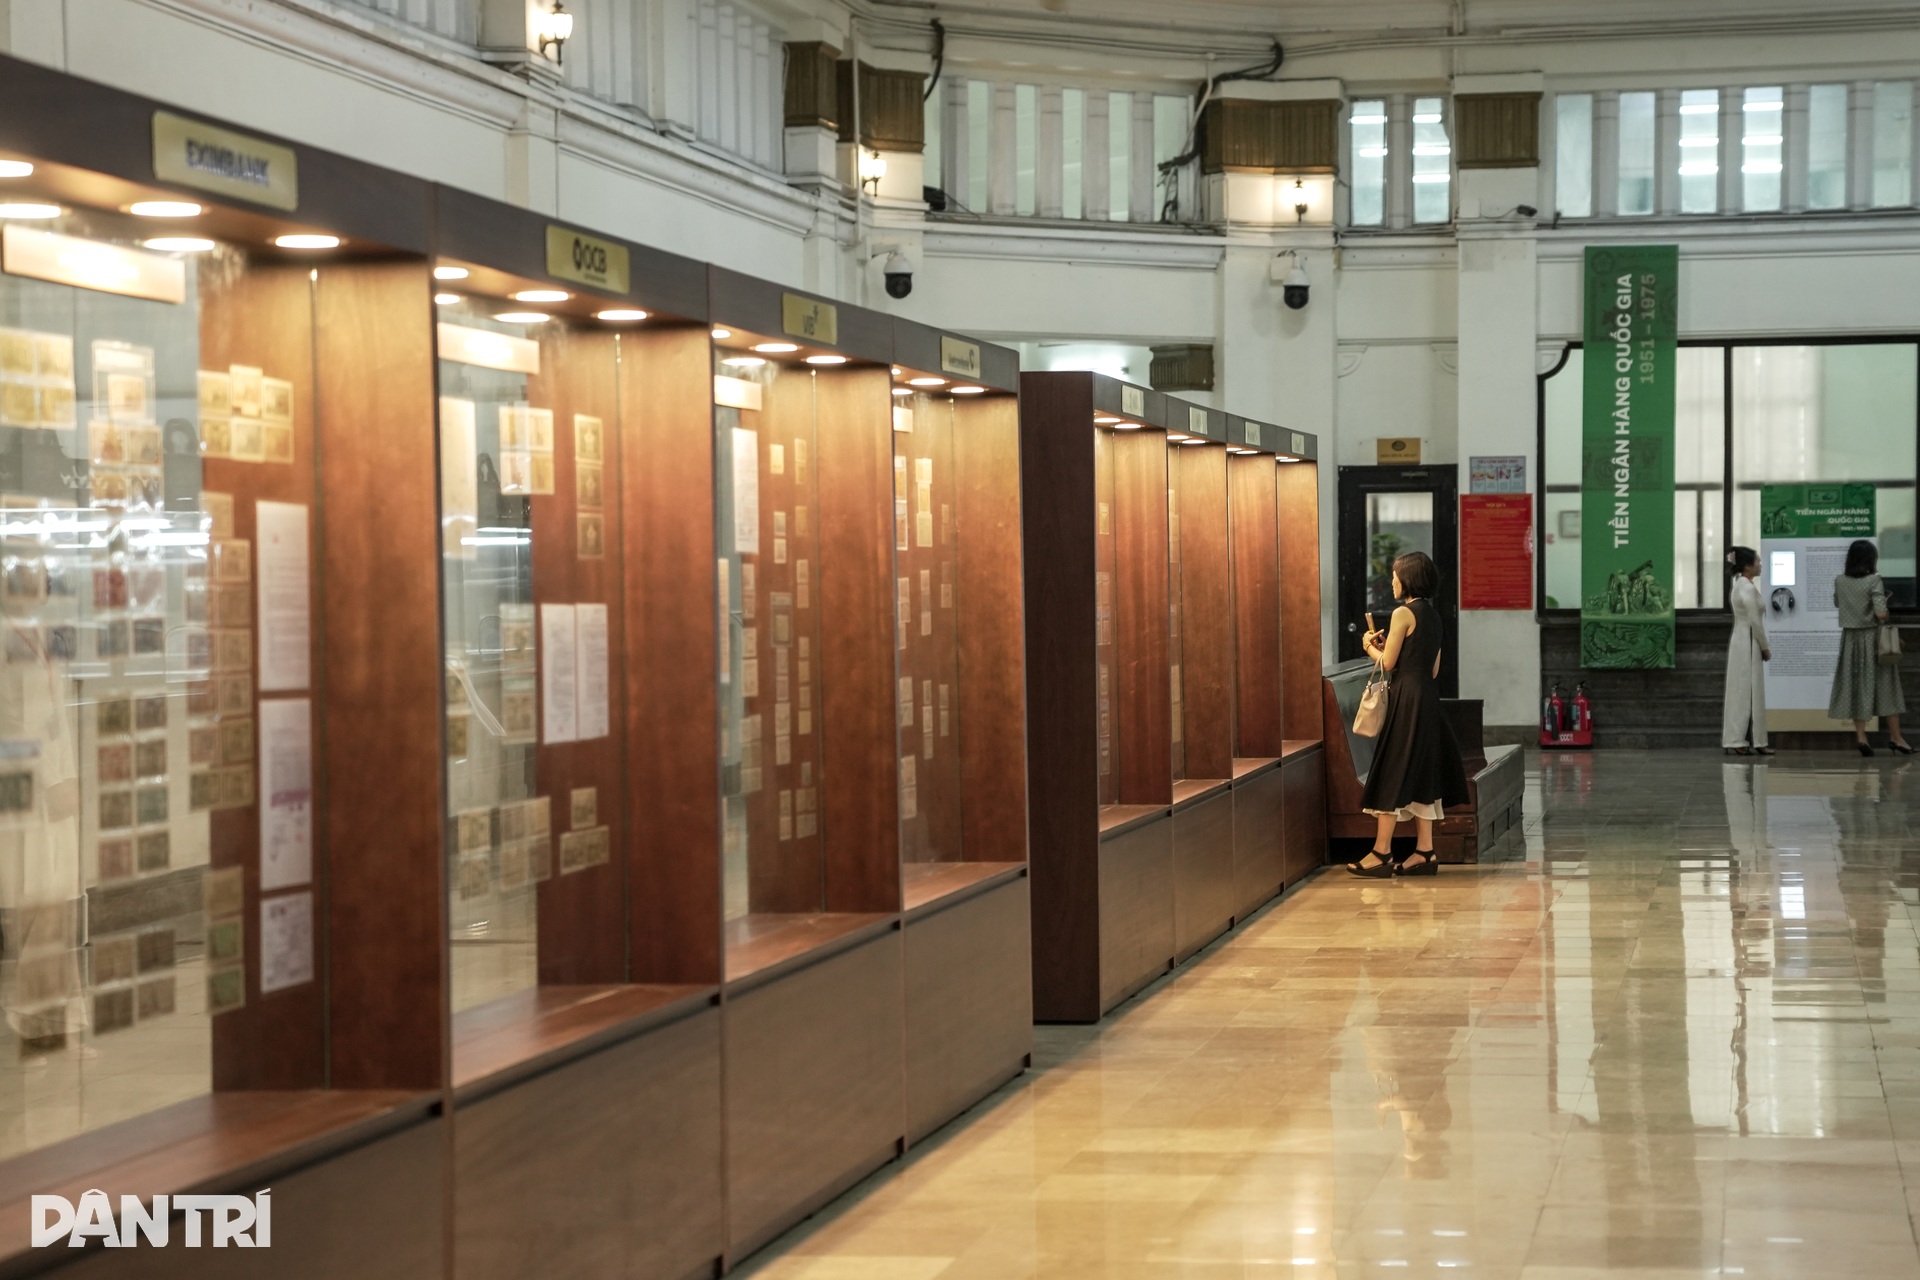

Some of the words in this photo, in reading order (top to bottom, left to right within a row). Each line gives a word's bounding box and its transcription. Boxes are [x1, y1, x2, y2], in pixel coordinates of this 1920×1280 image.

[1616, 273, 1633, 310] GIA
[1640, 273, 1656, 320] 1975
[1609, 312, 1633, 373] QUỐC
[1640, 338, 1655, 385] 1951
[1612, 376, 1632, 435] HÀNG
[1611, 439, 1631, 498] NGÂN
[1608, 502, 1630, 548] TIỀN
